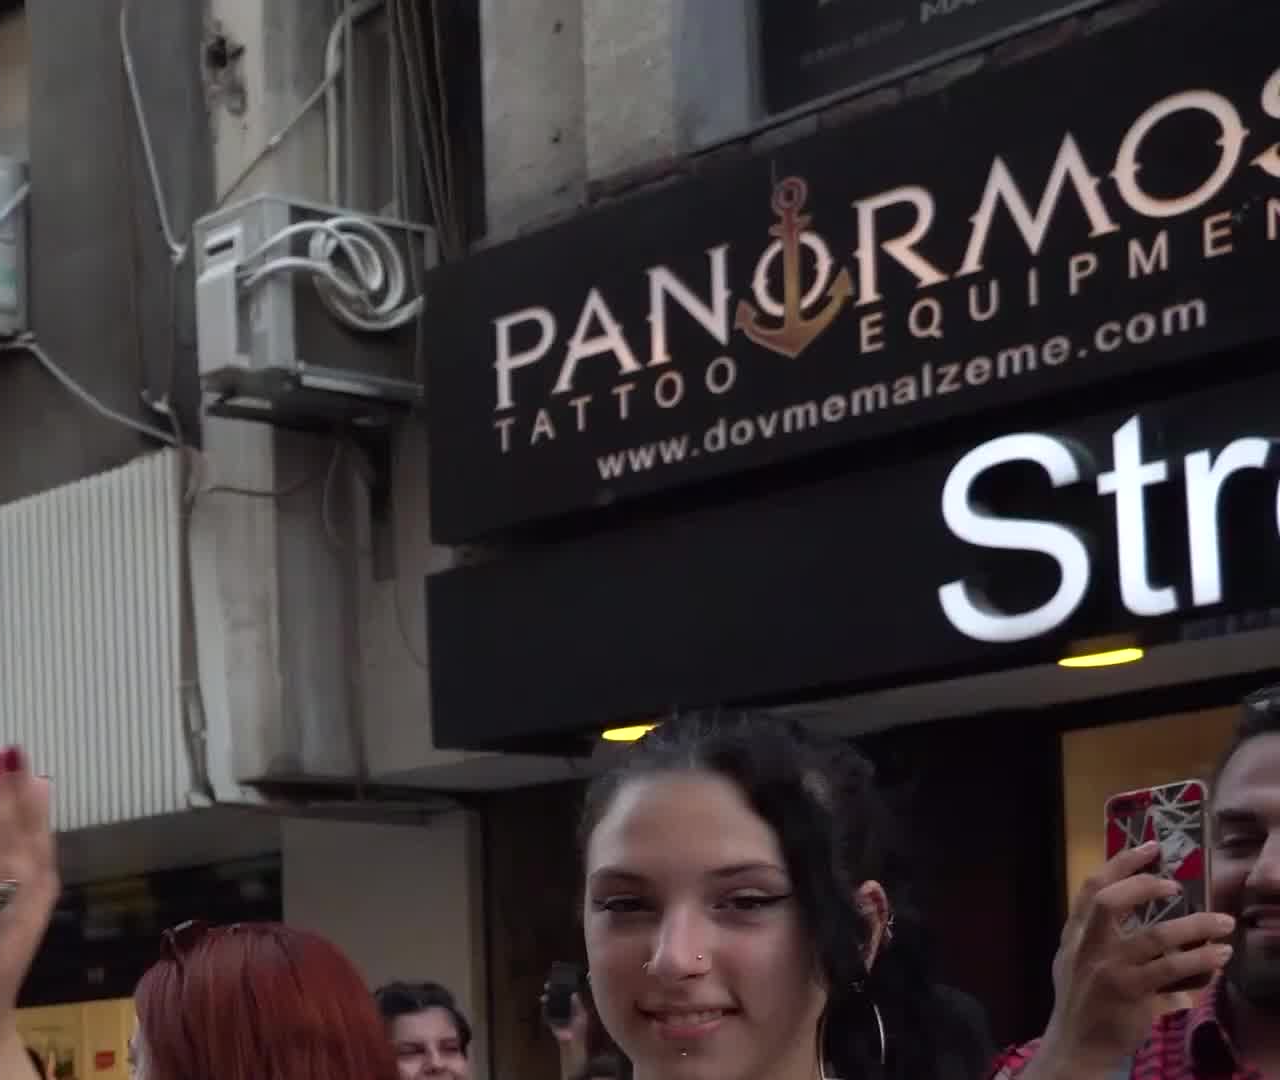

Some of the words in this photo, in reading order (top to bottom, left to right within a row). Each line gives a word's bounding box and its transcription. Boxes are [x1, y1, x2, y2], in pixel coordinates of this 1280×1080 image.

[494, 357, 737, 453] TATTOO
[596, 298, 1208, 482] www.dovmemalzeme.com
[936, 413, 1280, 644] Str
